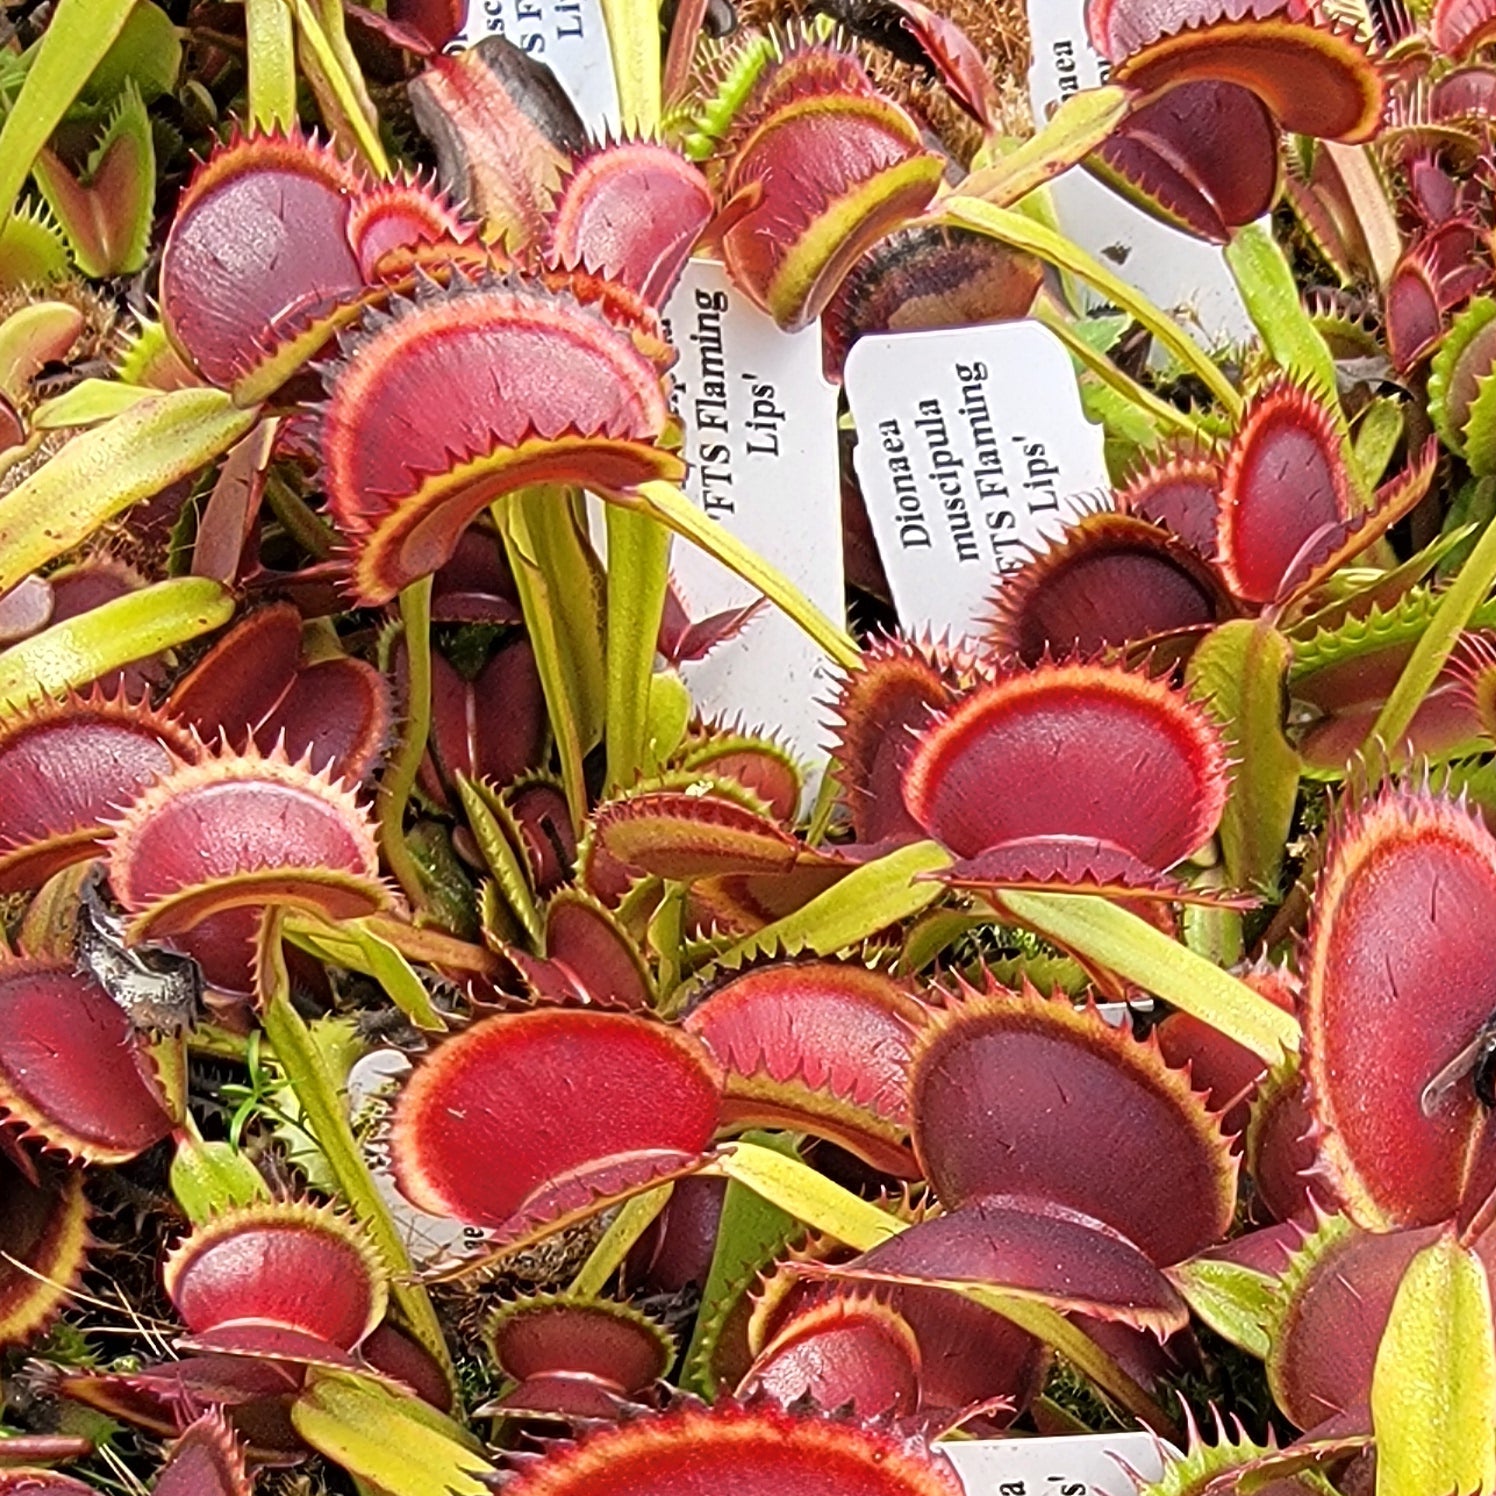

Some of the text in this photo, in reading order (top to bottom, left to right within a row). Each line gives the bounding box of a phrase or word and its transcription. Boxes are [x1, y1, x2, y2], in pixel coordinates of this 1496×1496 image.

[689, 288, 729, 433] Flaming
[741, 373, 786, 457] Lips'
[878, 418, 933, 550] Dionaea
[914, 399, 980, 563] muscipula
[955, 361, 1010, 500] Flaming
[1011, 435, 1060, 515] Lips'
